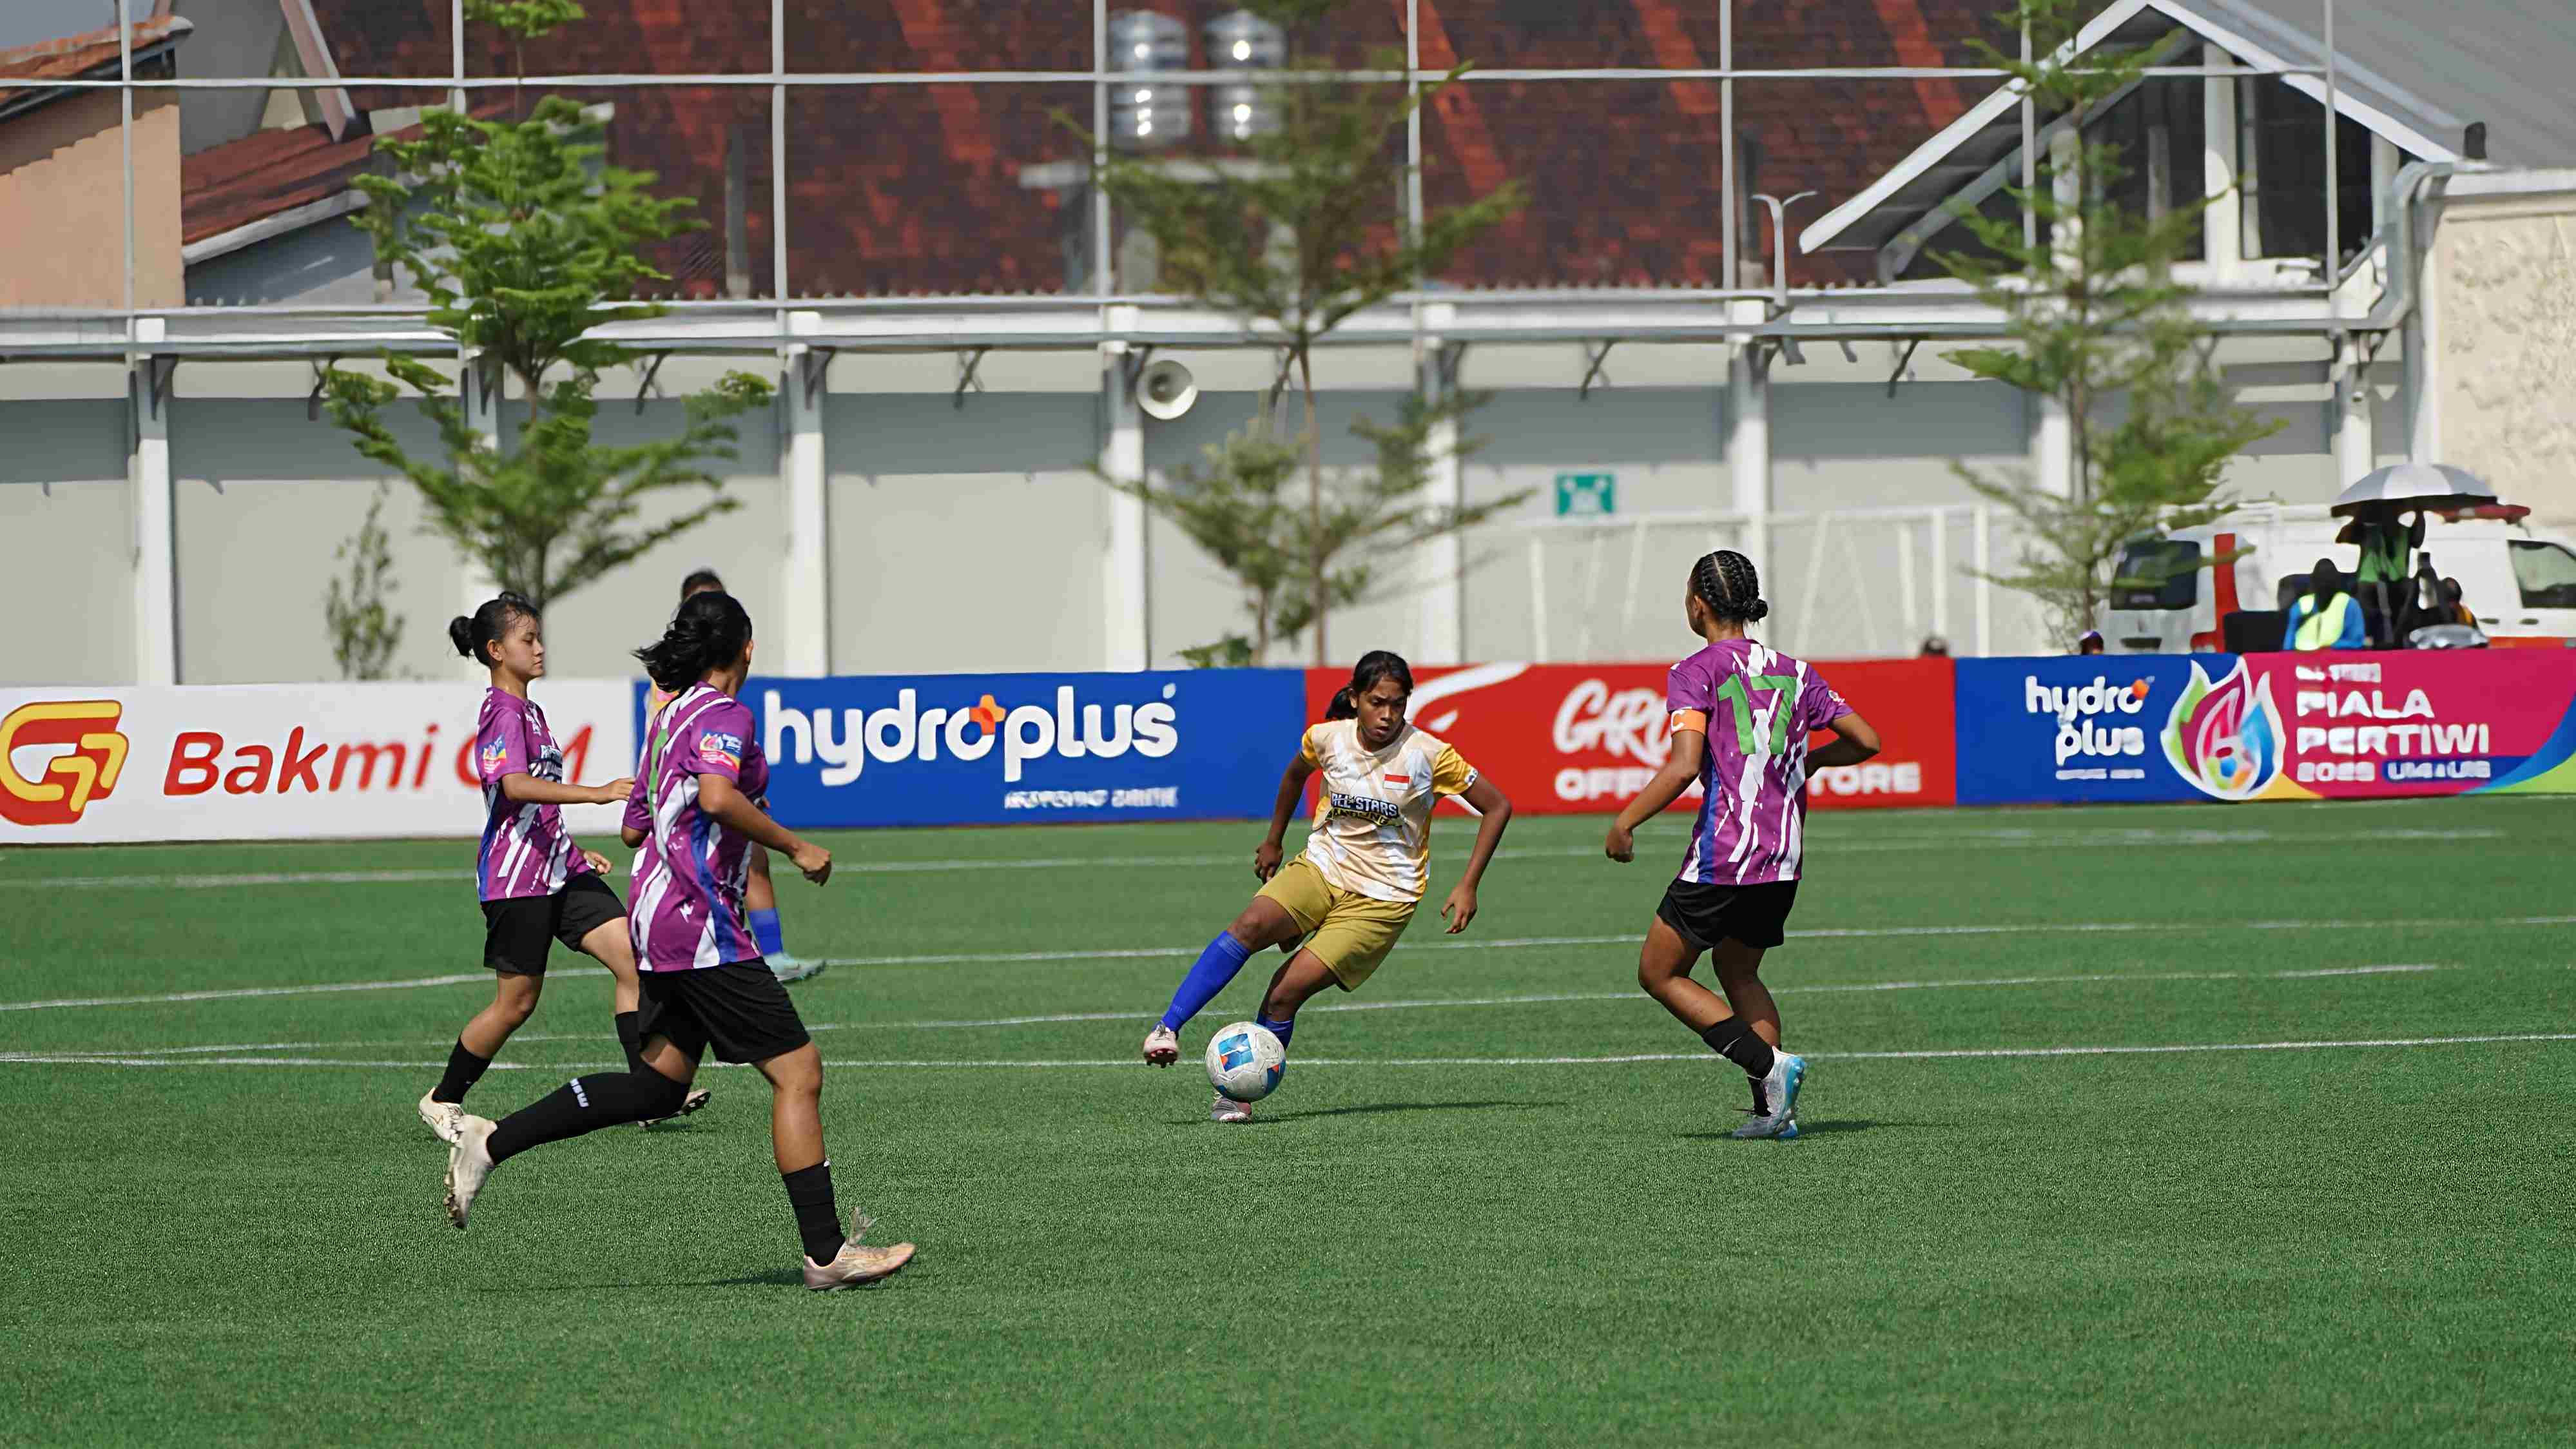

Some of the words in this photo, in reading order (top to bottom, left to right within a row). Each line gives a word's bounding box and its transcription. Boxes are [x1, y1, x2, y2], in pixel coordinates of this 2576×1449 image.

[1717, 674, 1797, 755] 17
[2026, 676, 2145, 727] hydro
[2296, 688, 2435, 719] PIALA
[764, 685, 1178, 786] hydroplus
[2055, 719, 2145, 766] plus
[2296, 723, 2489, 755] PERTIWI
[164, 726, 439, 795] Bakmi
[1806, 762, 1921, 796] TORE
[1355, 797, 1397, 817] STARS
